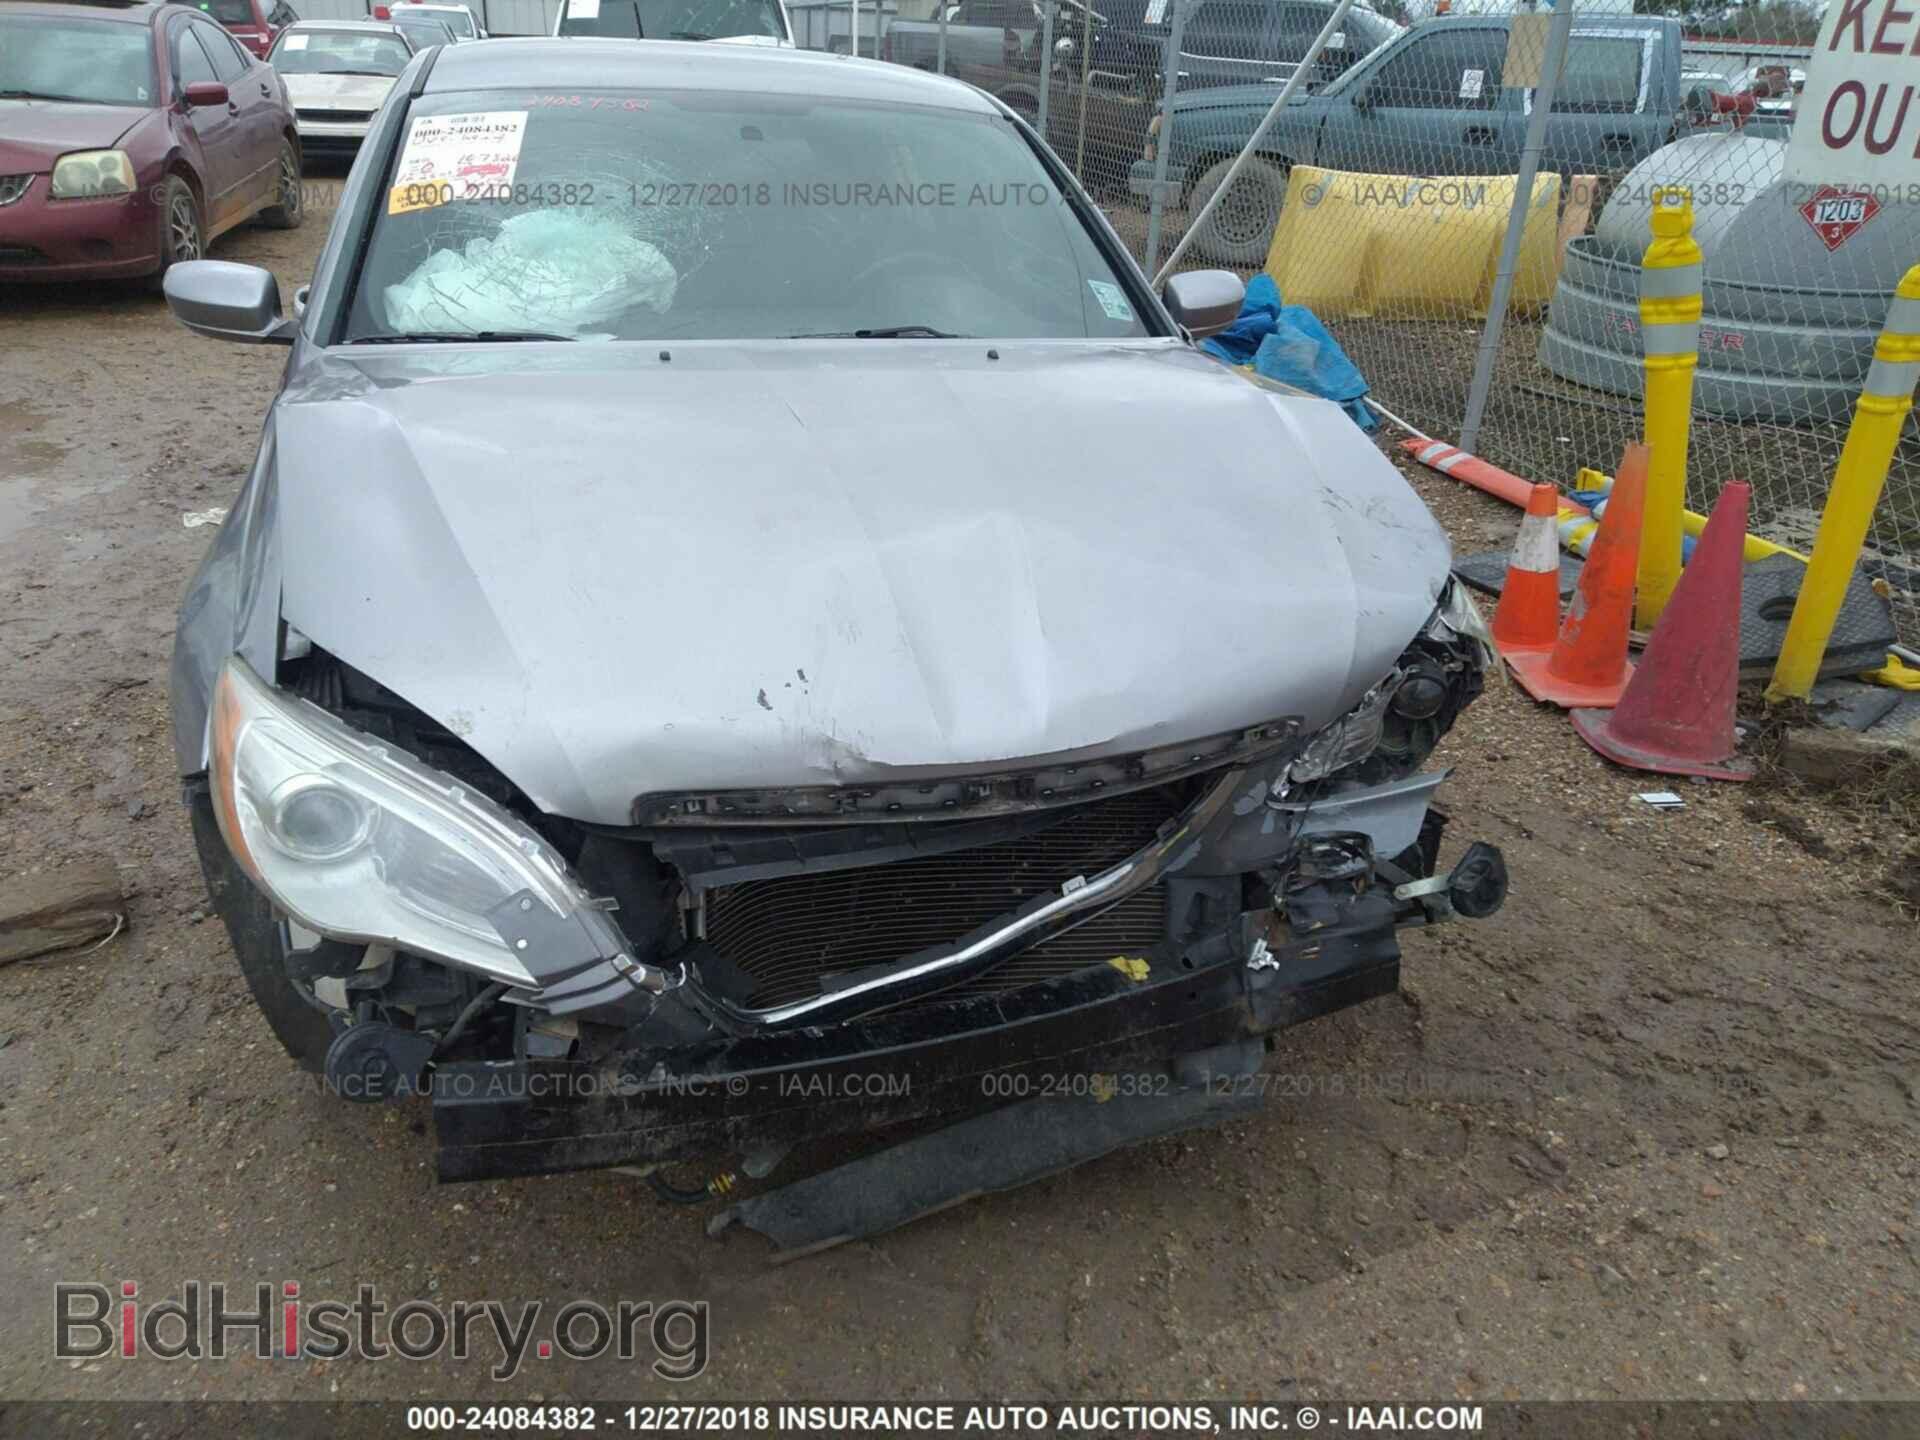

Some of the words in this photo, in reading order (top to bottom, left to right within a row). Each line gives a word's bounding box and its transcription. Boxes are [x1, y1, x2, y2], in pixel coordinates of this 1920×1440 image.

[1829, 0, 1920, 56] KE
[1822, 80, 1920, 160] OU
[1819, 201, 1862, 221] 1203
